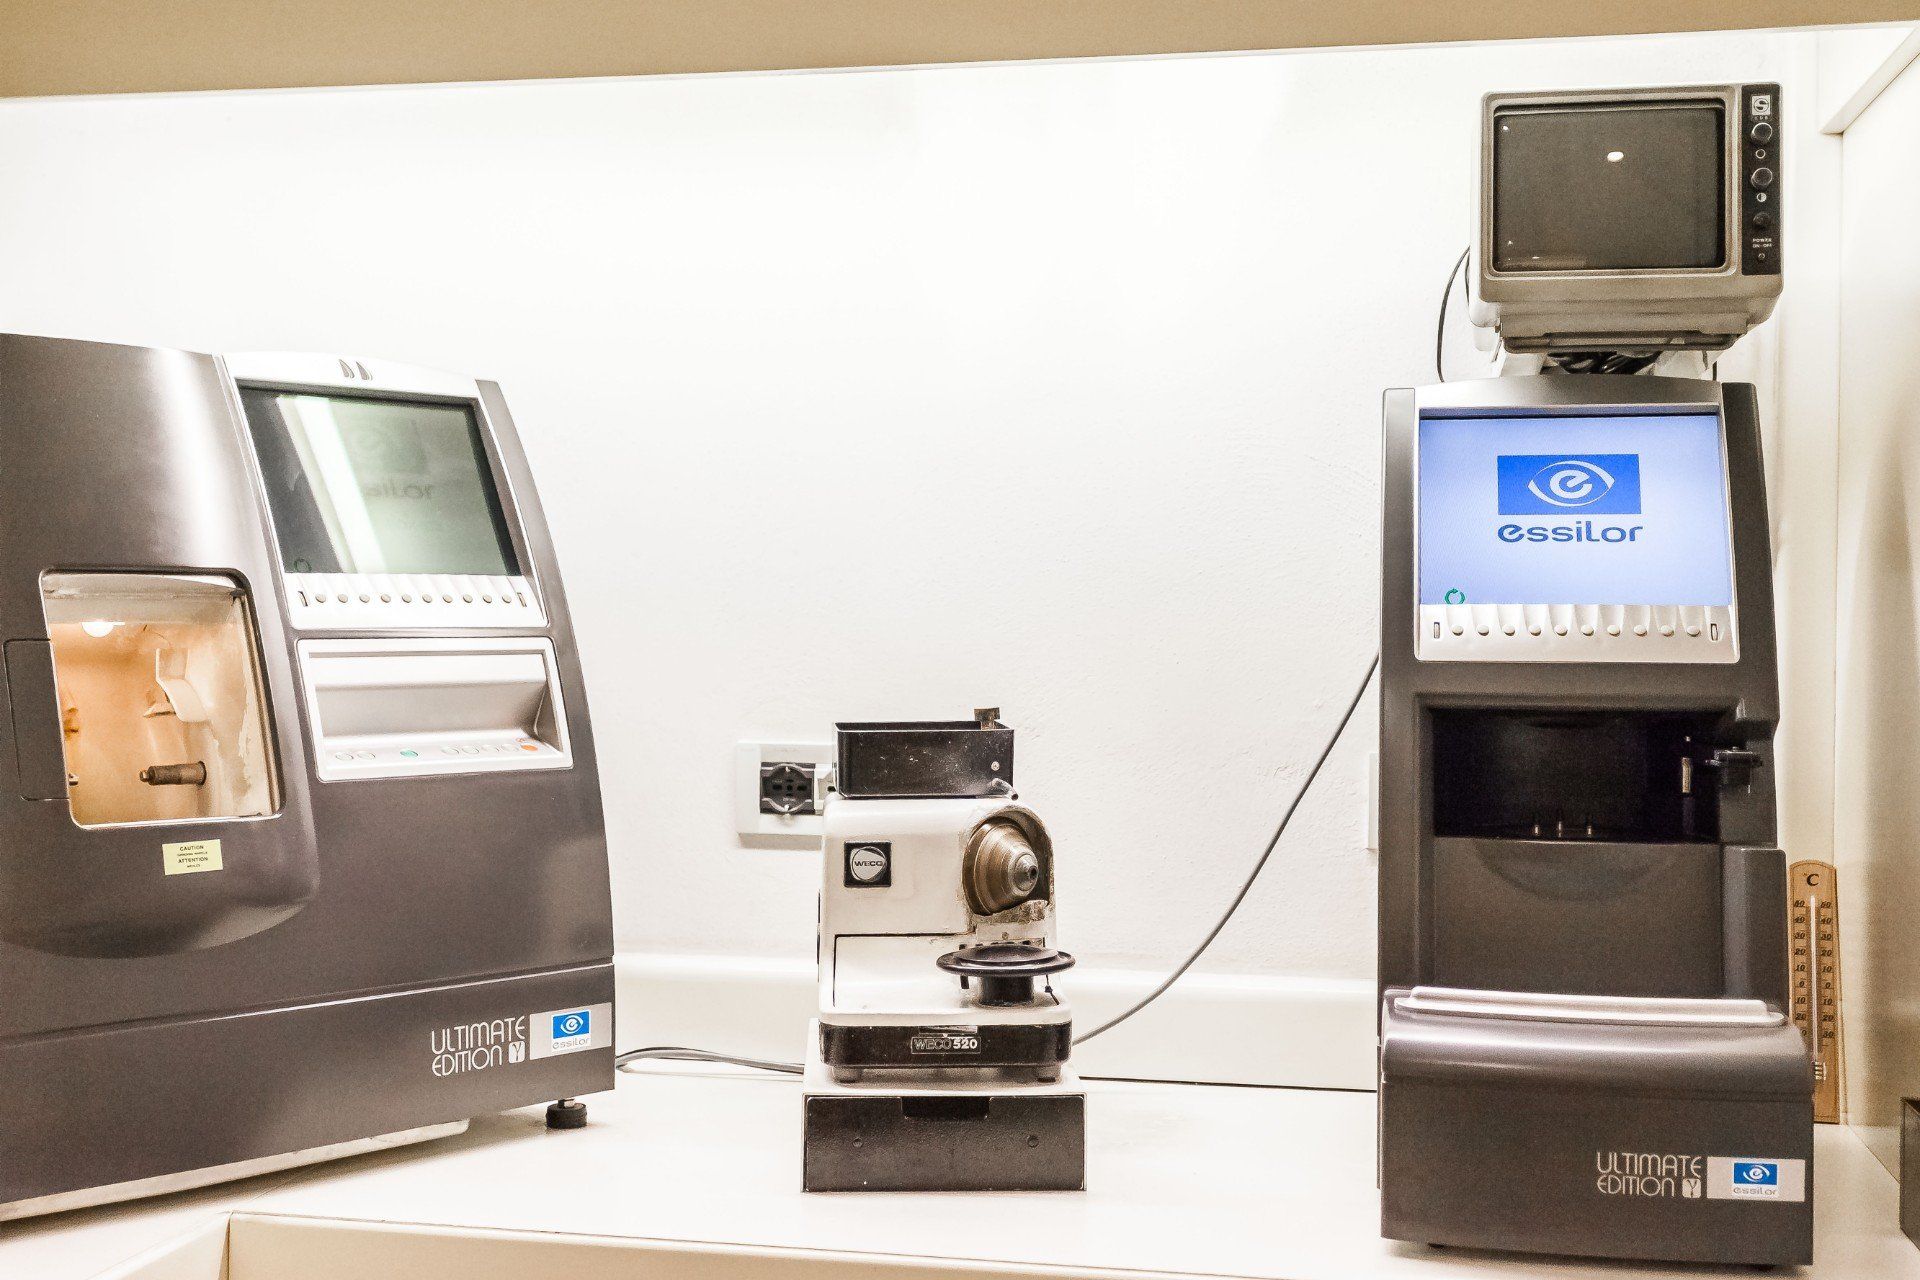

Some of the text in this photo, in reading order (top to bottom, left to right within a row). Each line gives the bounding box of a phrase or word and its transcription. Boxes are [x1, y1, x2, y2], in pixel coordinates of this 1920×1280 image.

[1497, 520, 1643, 543] essilor
[177, 856, 208, 864] ATTENTION
[1821, 917, 1831, 925] 40
[1794, 947, 1806, 955] 20
[1796, 996, 1805, 1004] 10
[1795, 1012, 1806, 1020] 20
[431, 1015, 525, 1055] ULTIMATE
[1823, 1030, 1834, 1038] 30
[552, 1036, 590, 1050] essilor
[952, 1038, 978, 1050] 520
[431, 1044, 503, 1077] EDITION
[1596, 1151, 1702, 1178] ULTIMATE
[1596, 1174, 1675, 1198] EDITION
[1733, 1187, 1776, 1195] essilor
